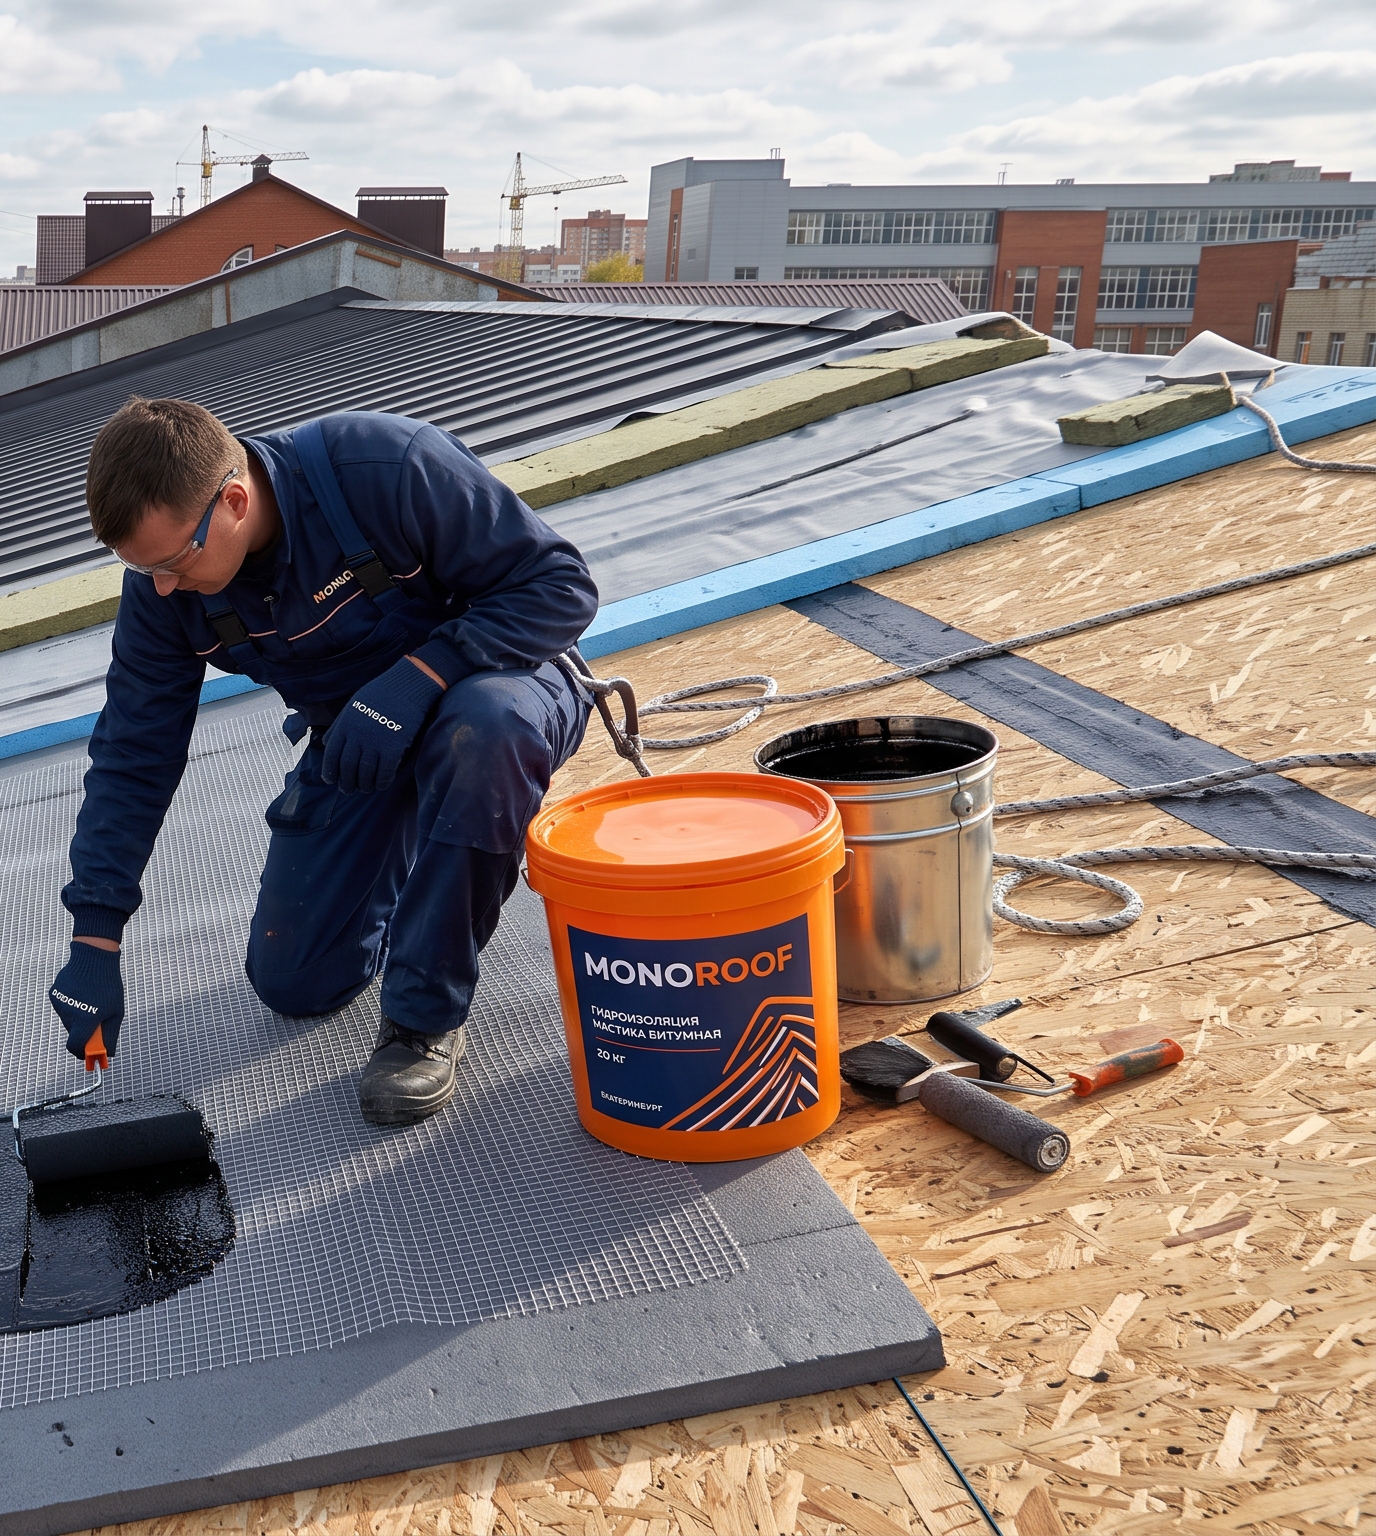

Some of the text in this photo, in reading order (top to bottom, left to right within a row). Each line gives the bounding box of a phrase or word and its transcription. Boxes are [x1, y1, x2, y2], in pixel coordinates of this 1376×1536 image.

[584, 943, 793, 988] MONOROOF
[591, 1005, 699, 1027] ГИДРОИЗОЛЯЦИЯ
[592, 1019, 722, 1040] МАСТИКА БИТУМНАЯ
[596, 1048, 610, 1060] 20
